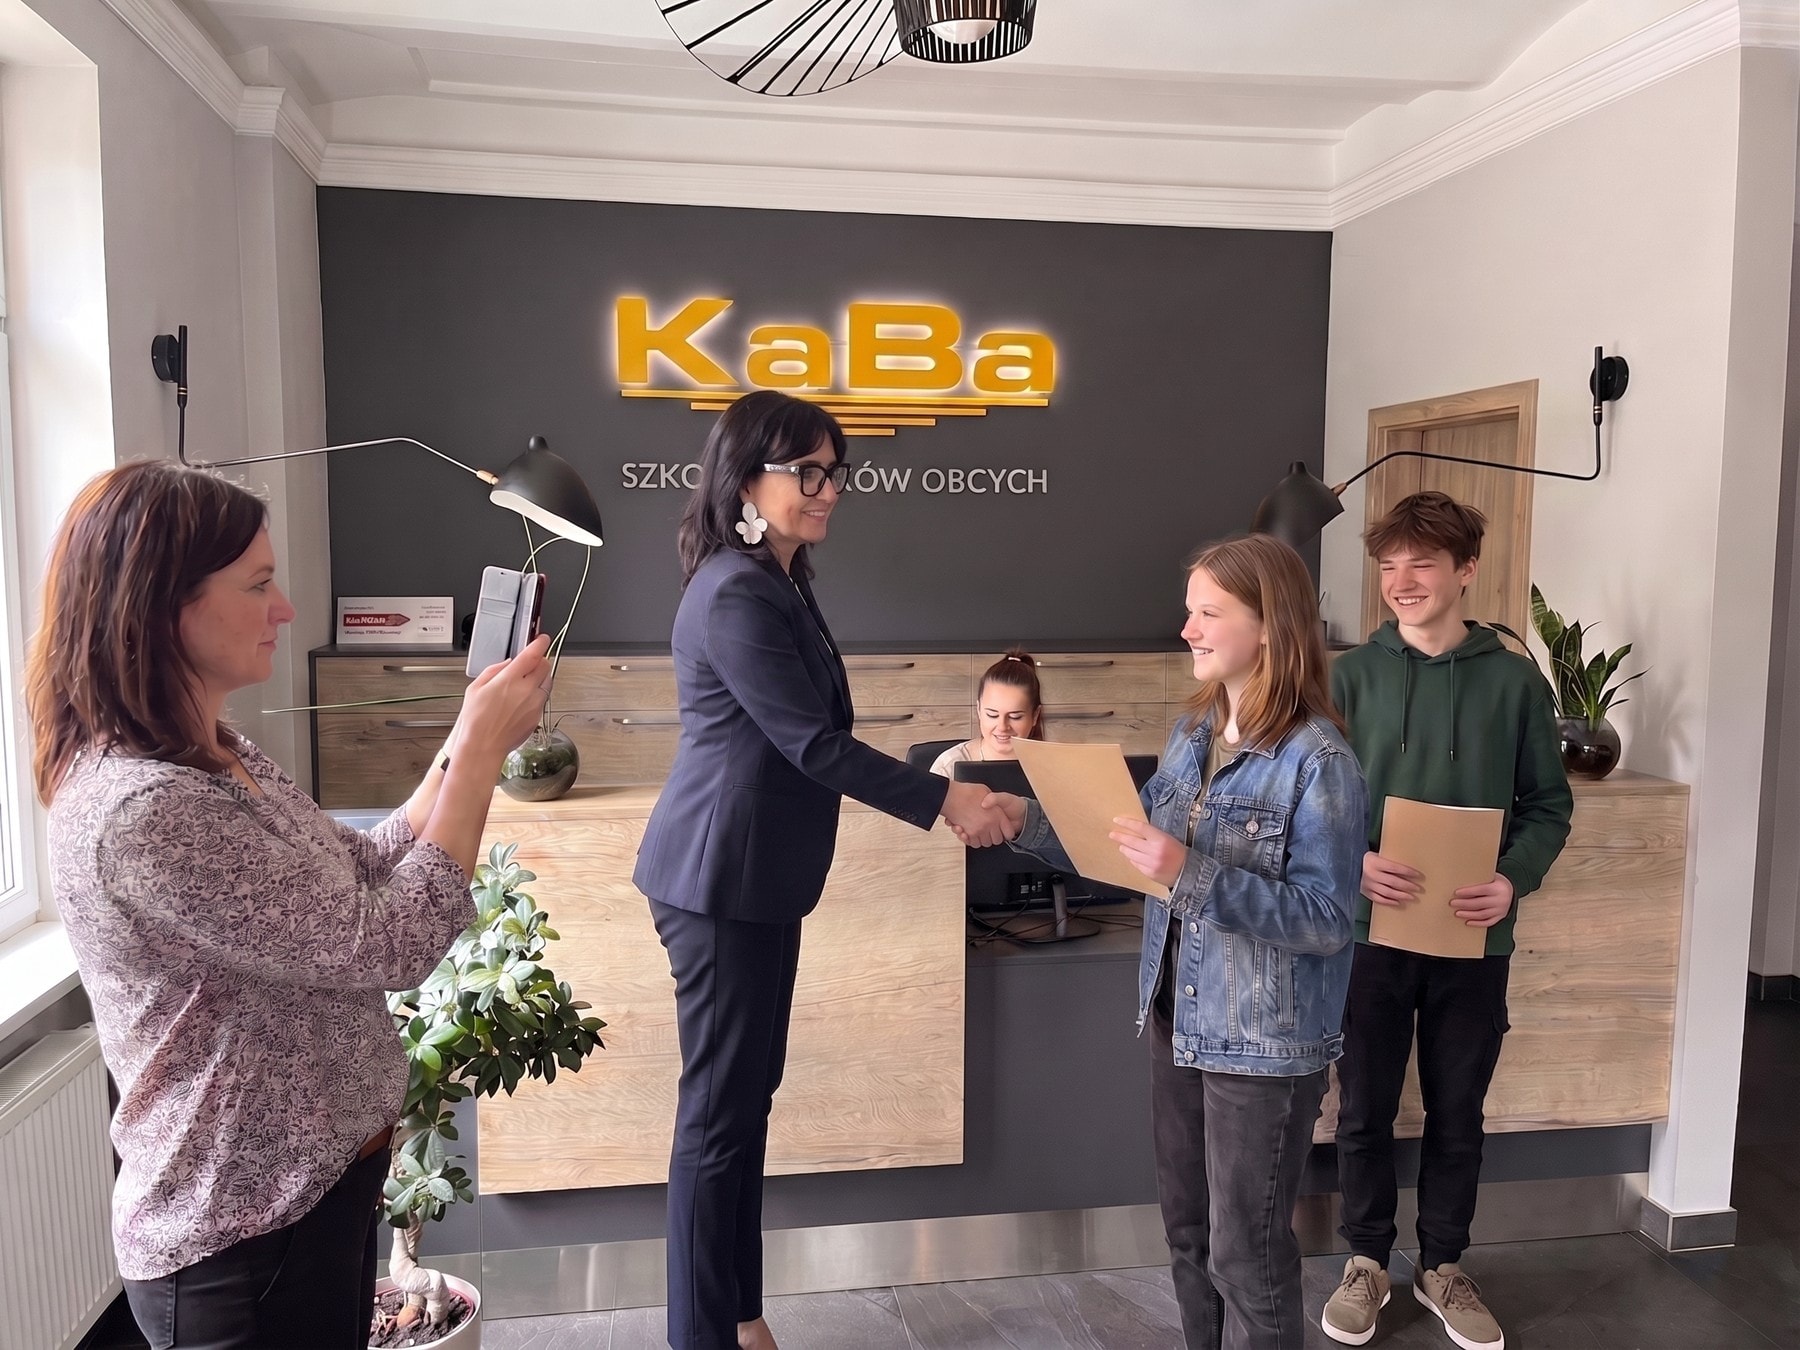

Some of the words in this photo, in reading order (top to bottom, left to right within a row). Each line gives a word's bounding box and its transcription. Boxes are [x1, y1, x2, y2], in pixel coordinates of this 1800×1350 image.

[616, 296, 1056, 394] KaBa
[621, 462, 704, 490] SZKO
[921, 468, 1048, 494] OBCYCH
